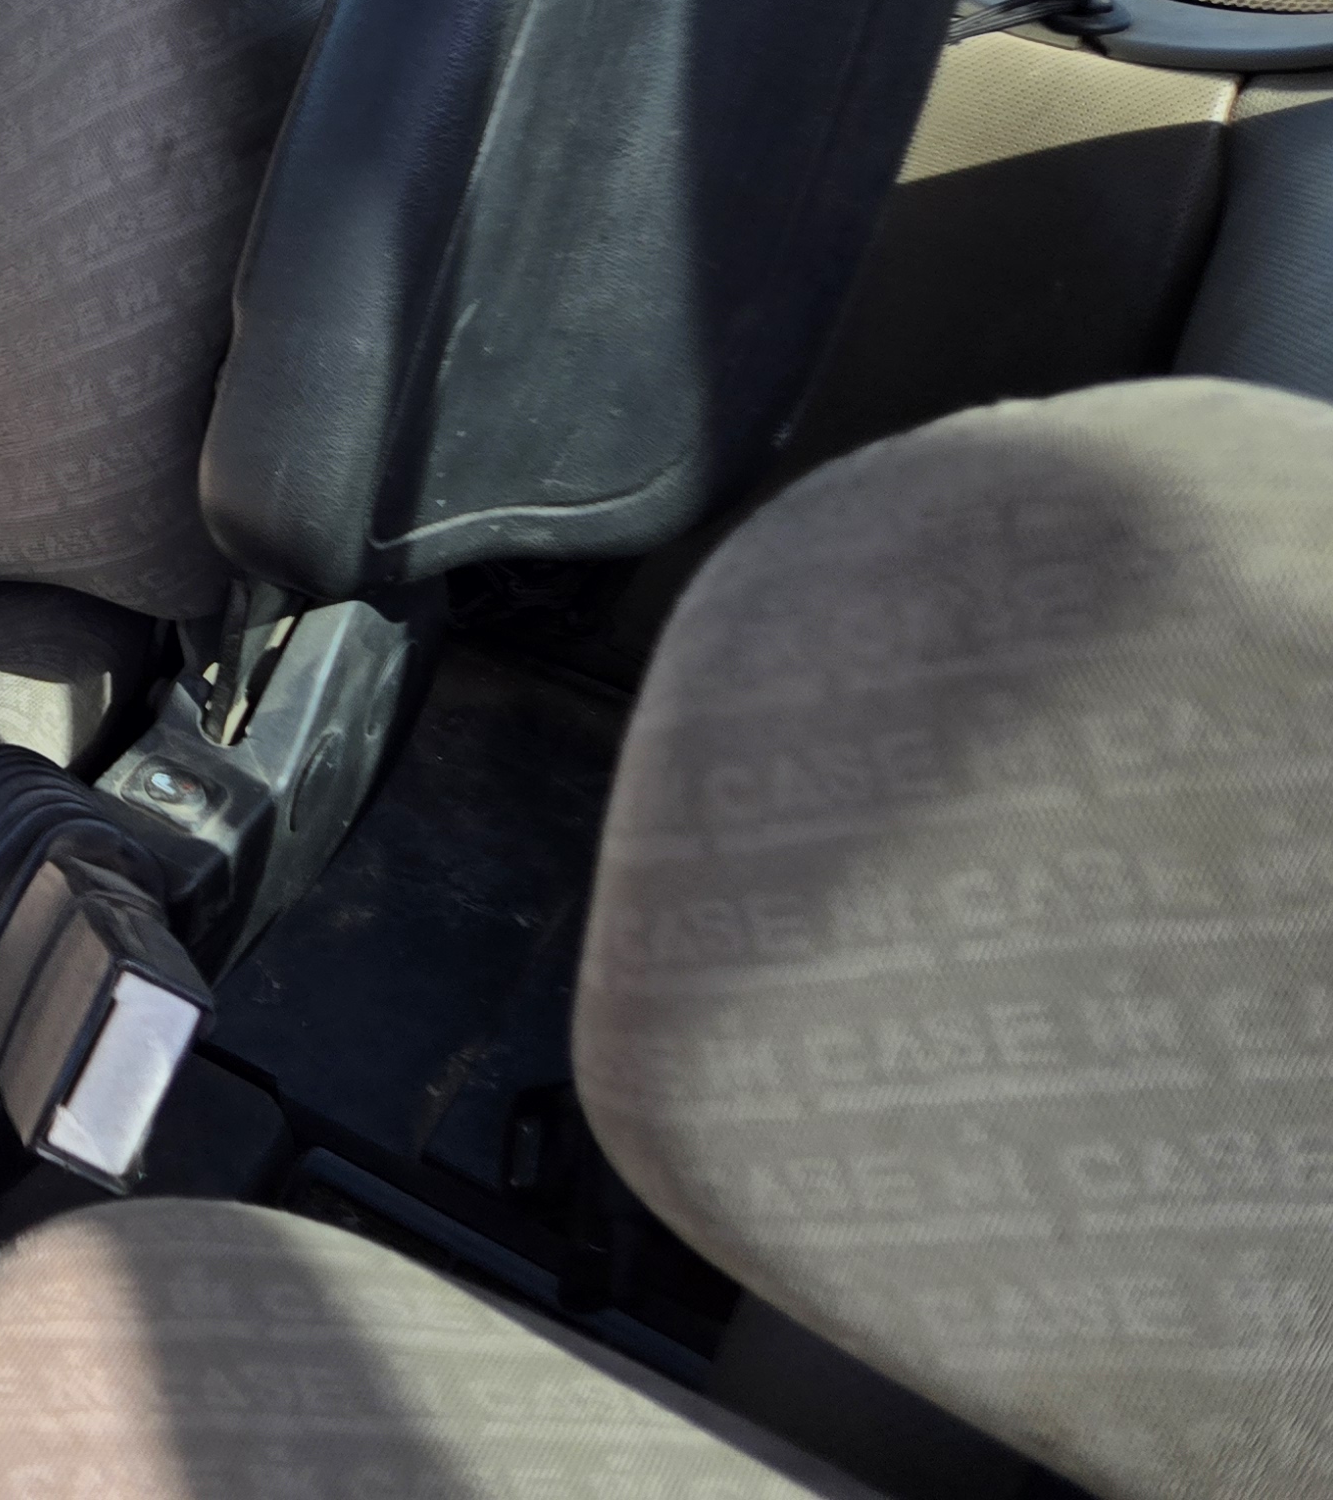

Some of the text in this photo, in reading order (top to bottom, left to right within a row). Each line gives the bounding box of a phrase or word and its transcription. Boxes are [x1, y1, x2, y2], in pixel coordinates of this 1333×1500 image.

[705, 730, 939, 820] CASE
[801, 1002, 1057, 1085] CASE
[743, 1155, 927, 1216] ASE
